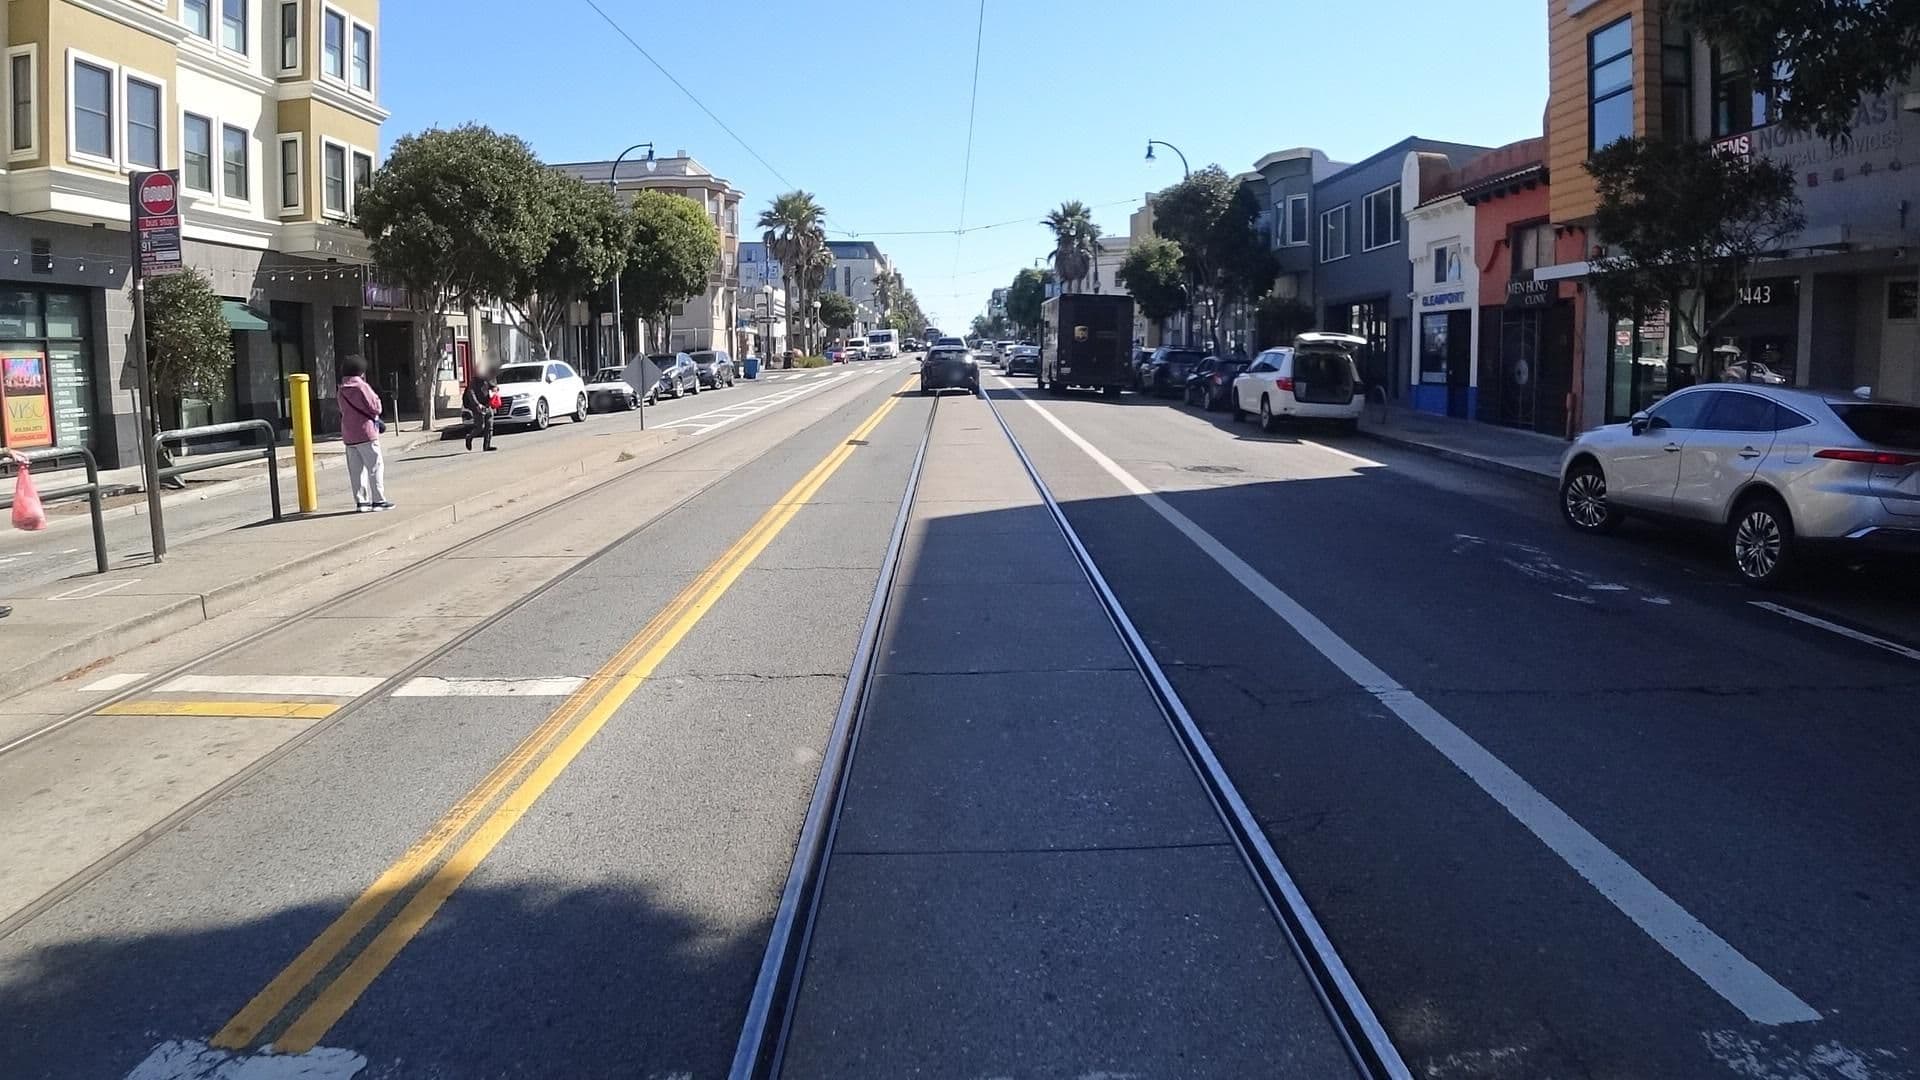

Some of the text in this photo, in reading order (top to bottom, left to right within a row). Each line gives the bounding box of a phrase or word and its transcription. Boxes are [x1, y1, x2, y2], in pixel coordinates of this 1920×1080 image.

[1711, 136, 1749, 160] NEMS
[146, 217, 175, 227] bus stop
[141, 242, 151, 252] 91
[1737, 285, 1771, 305] 1443
